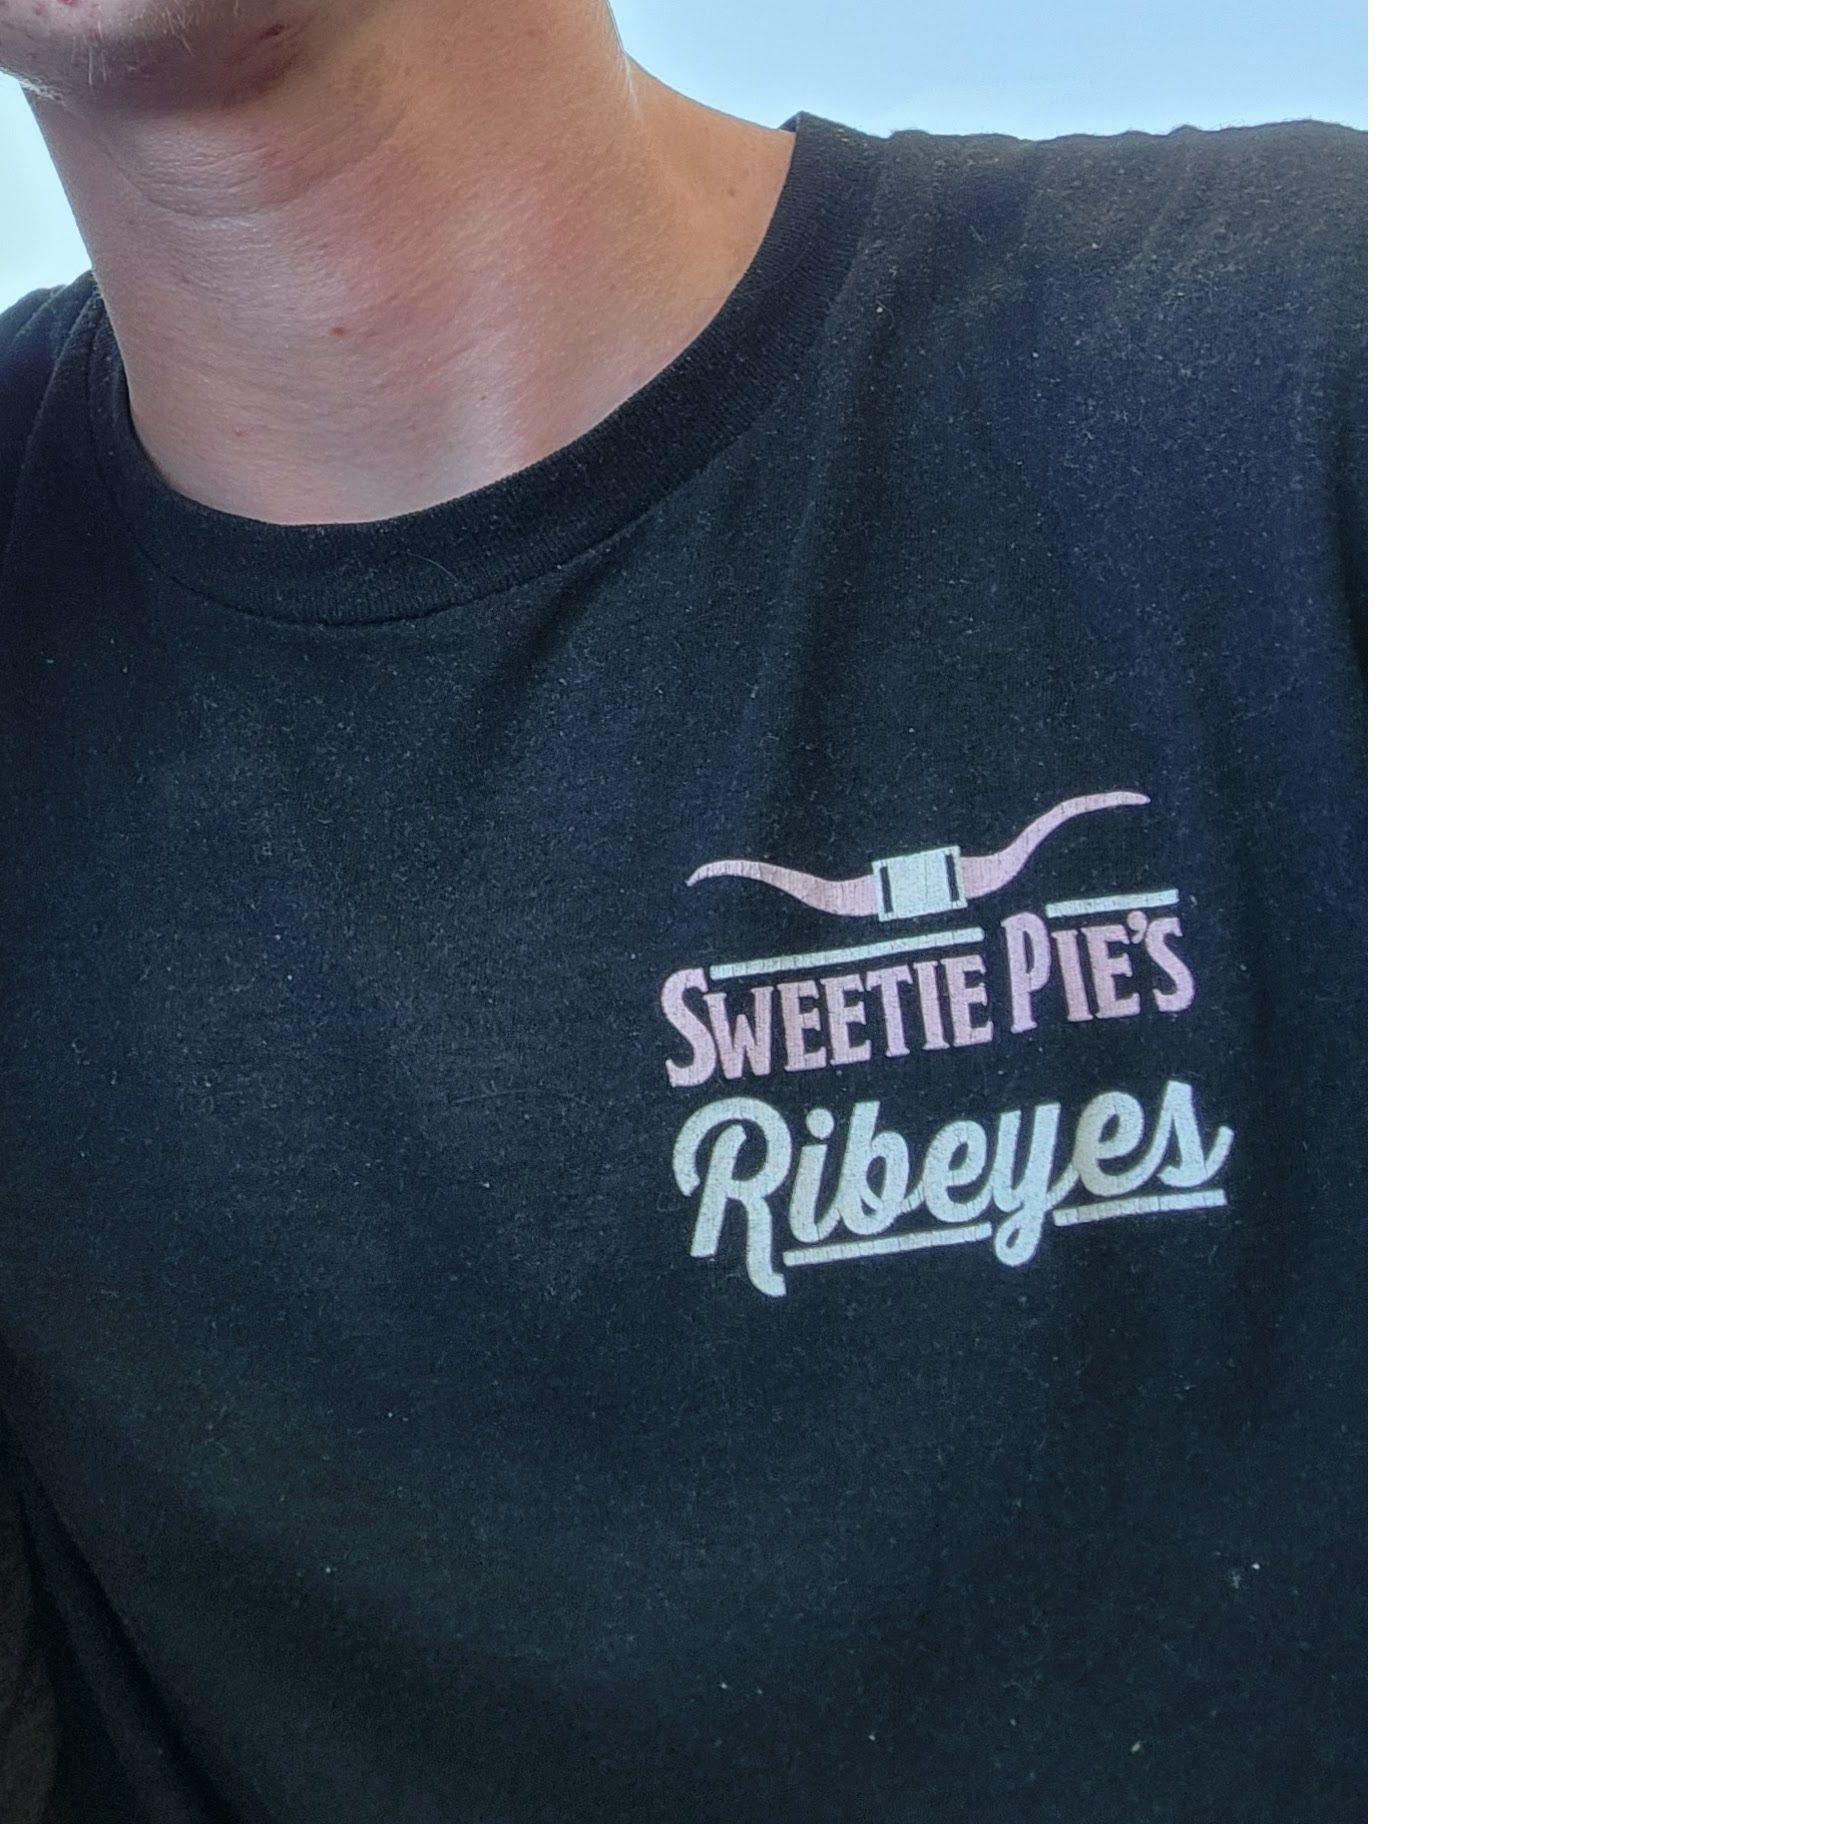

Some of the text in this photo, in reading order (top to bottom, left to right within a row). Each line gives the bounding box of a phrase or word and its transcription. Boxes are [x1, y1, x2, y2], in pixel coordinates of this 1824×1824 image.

[660, 911, 1195, 1087] SWEETIE PIE'S
[673, 1080, 1234, 1297] Ribeyes
